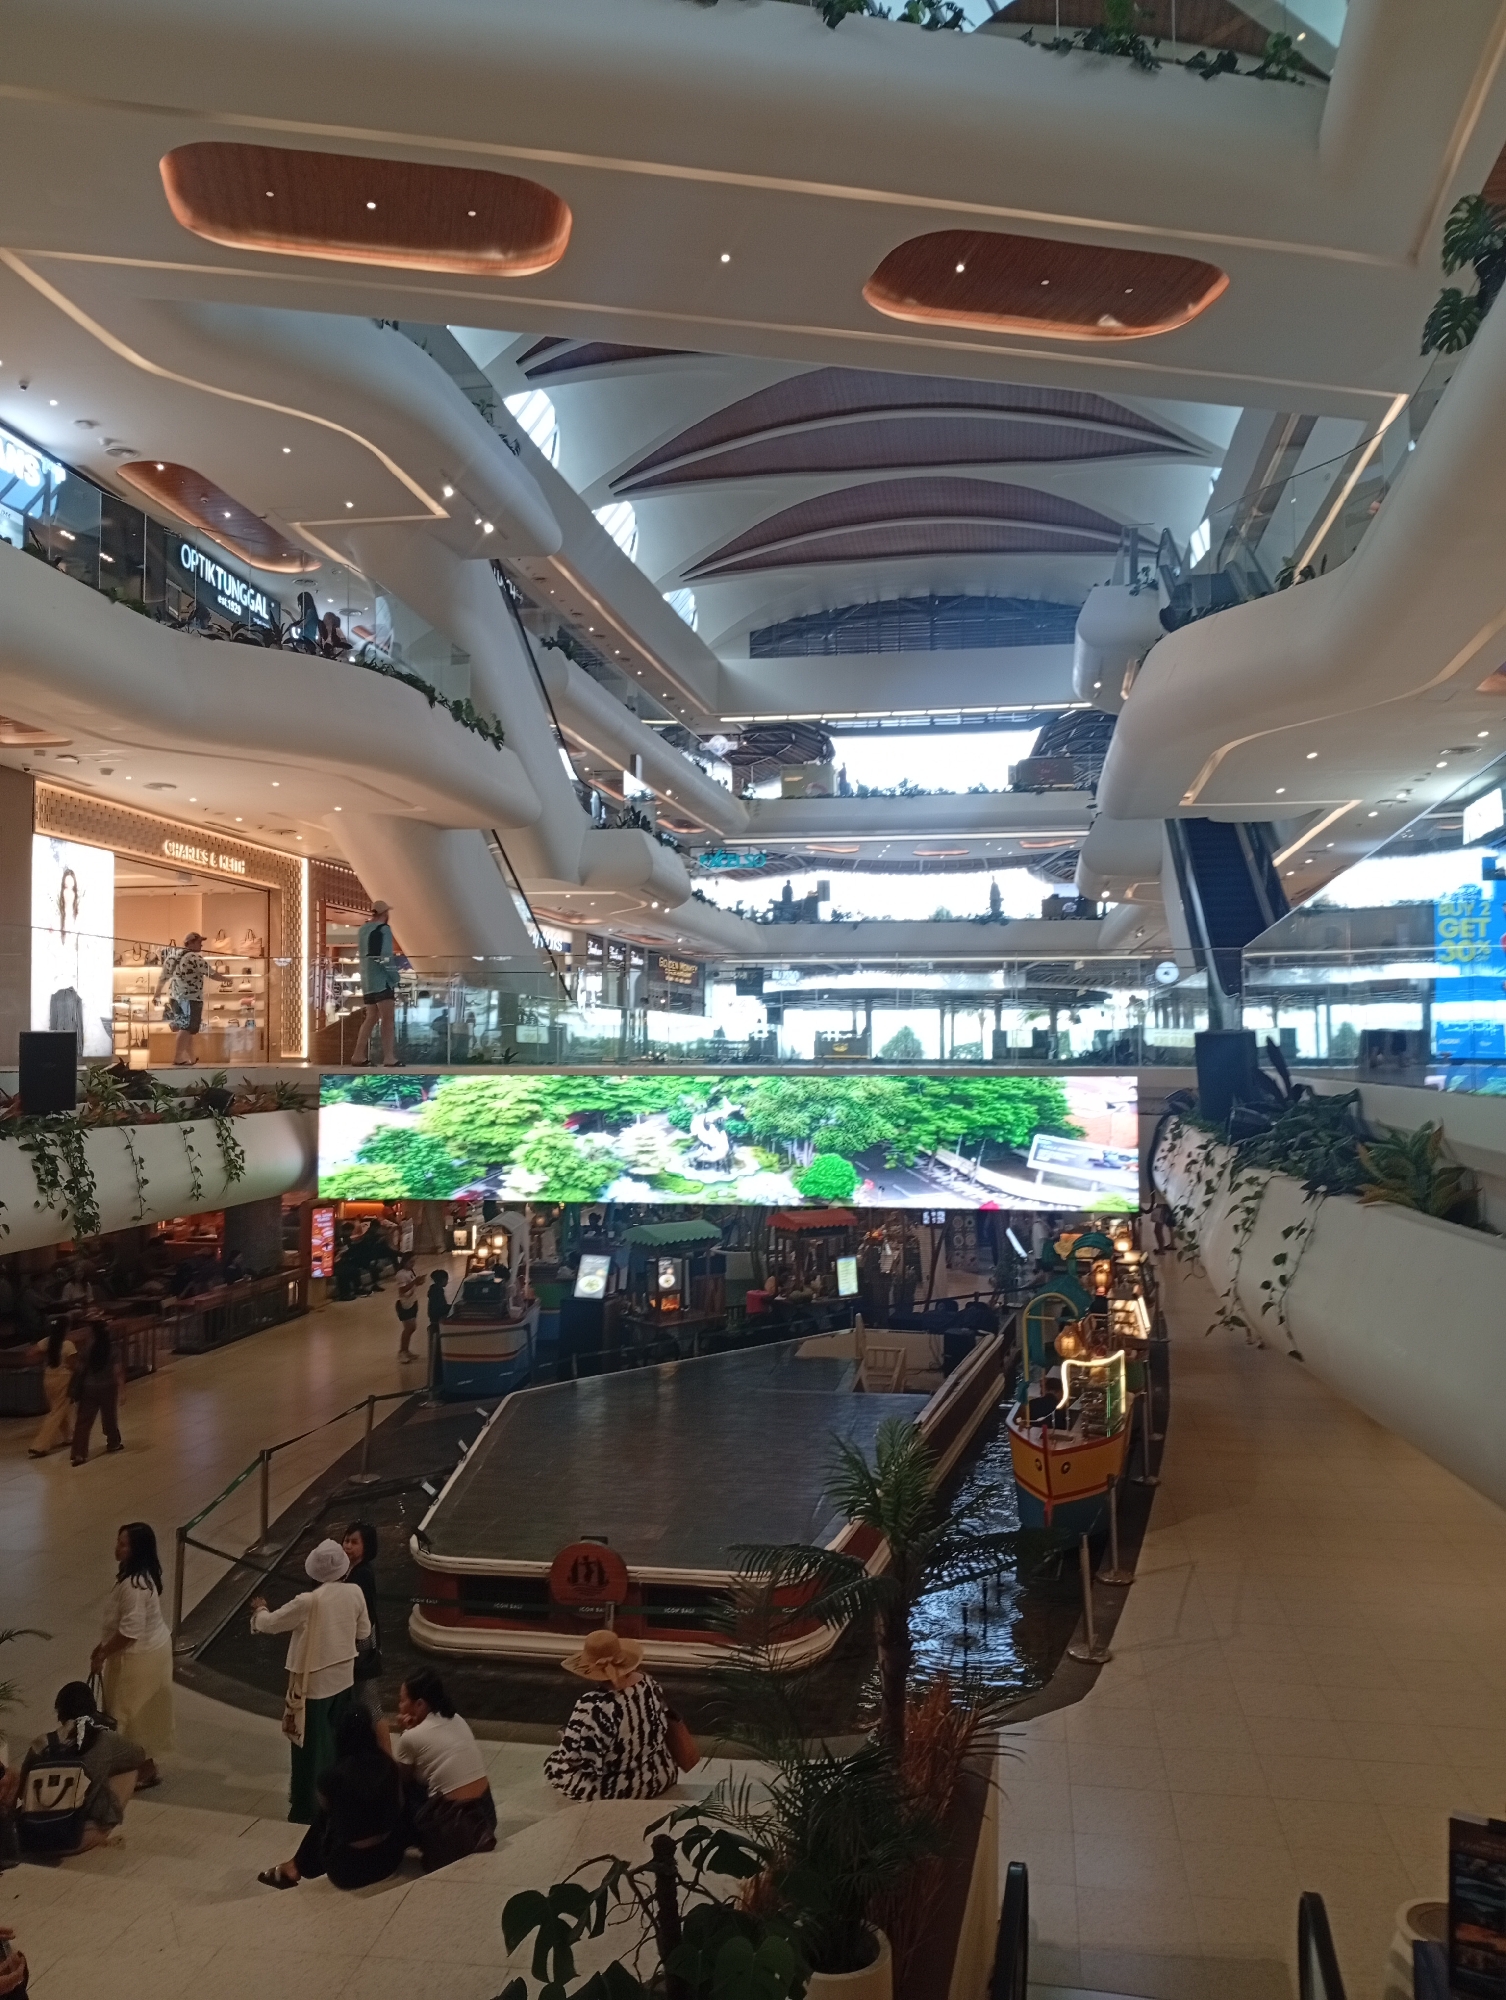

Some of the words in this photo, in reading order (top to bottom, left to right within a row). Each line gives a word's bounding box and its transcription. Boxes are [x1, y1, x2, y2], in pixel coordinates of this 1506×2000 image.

[163, 840, 209, 865] CHARLES
[219, 854, 246, 874] KEITH
[698, 848, 767, 869] EXCELSO
[1438, 901, 1475, 916] BUY
[1480, 901, 1491, 916] 2
[1438, 917, 1491, 938] GET
[659, 956, 680, 972] GOLDEN
